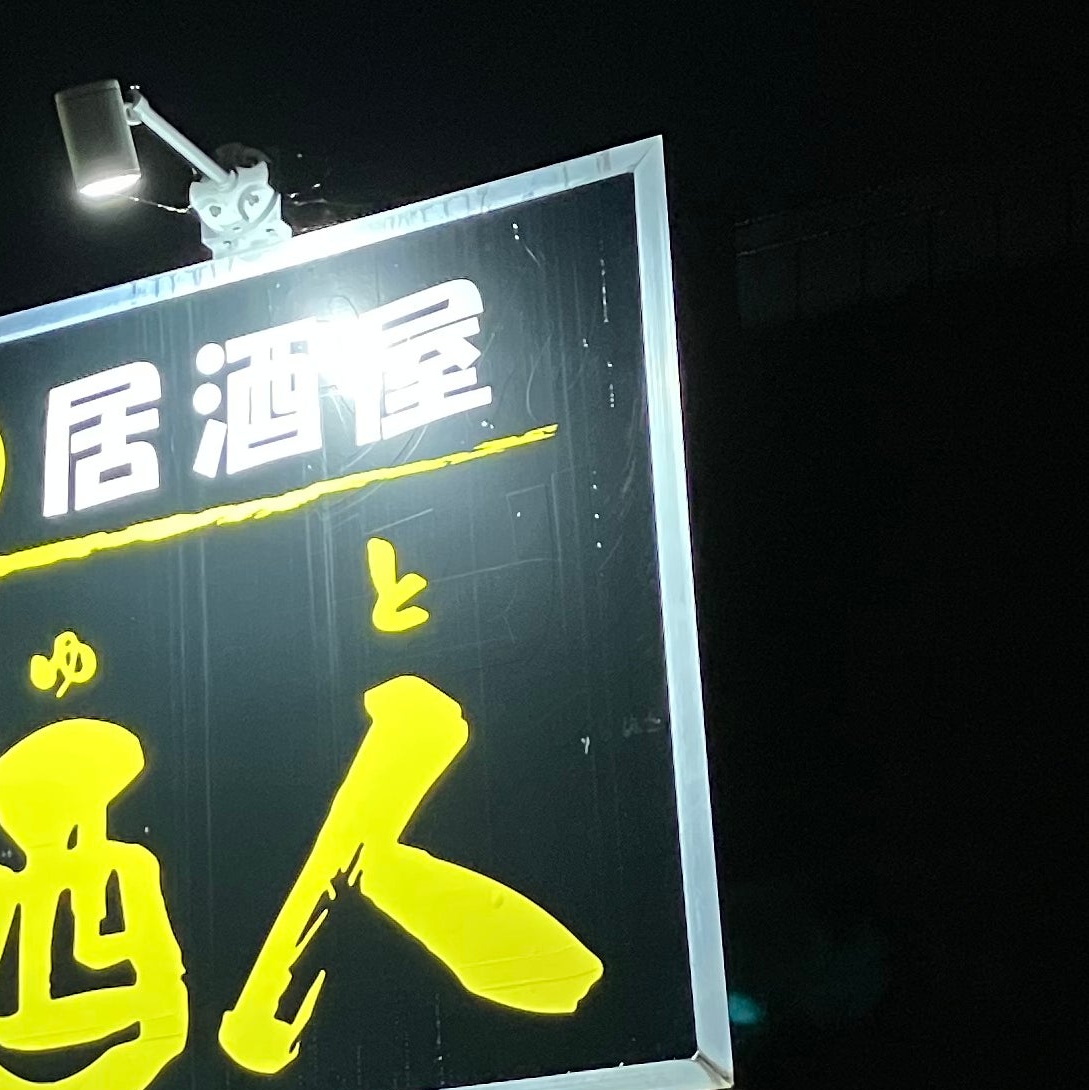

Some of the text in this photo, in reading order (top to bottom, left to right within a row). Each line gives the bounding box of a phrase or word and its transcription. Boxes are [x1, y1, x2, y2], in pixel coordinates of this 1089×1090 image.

[42, 278, 493, 518] 居酒屋
[366, 537, 430, 635] と
